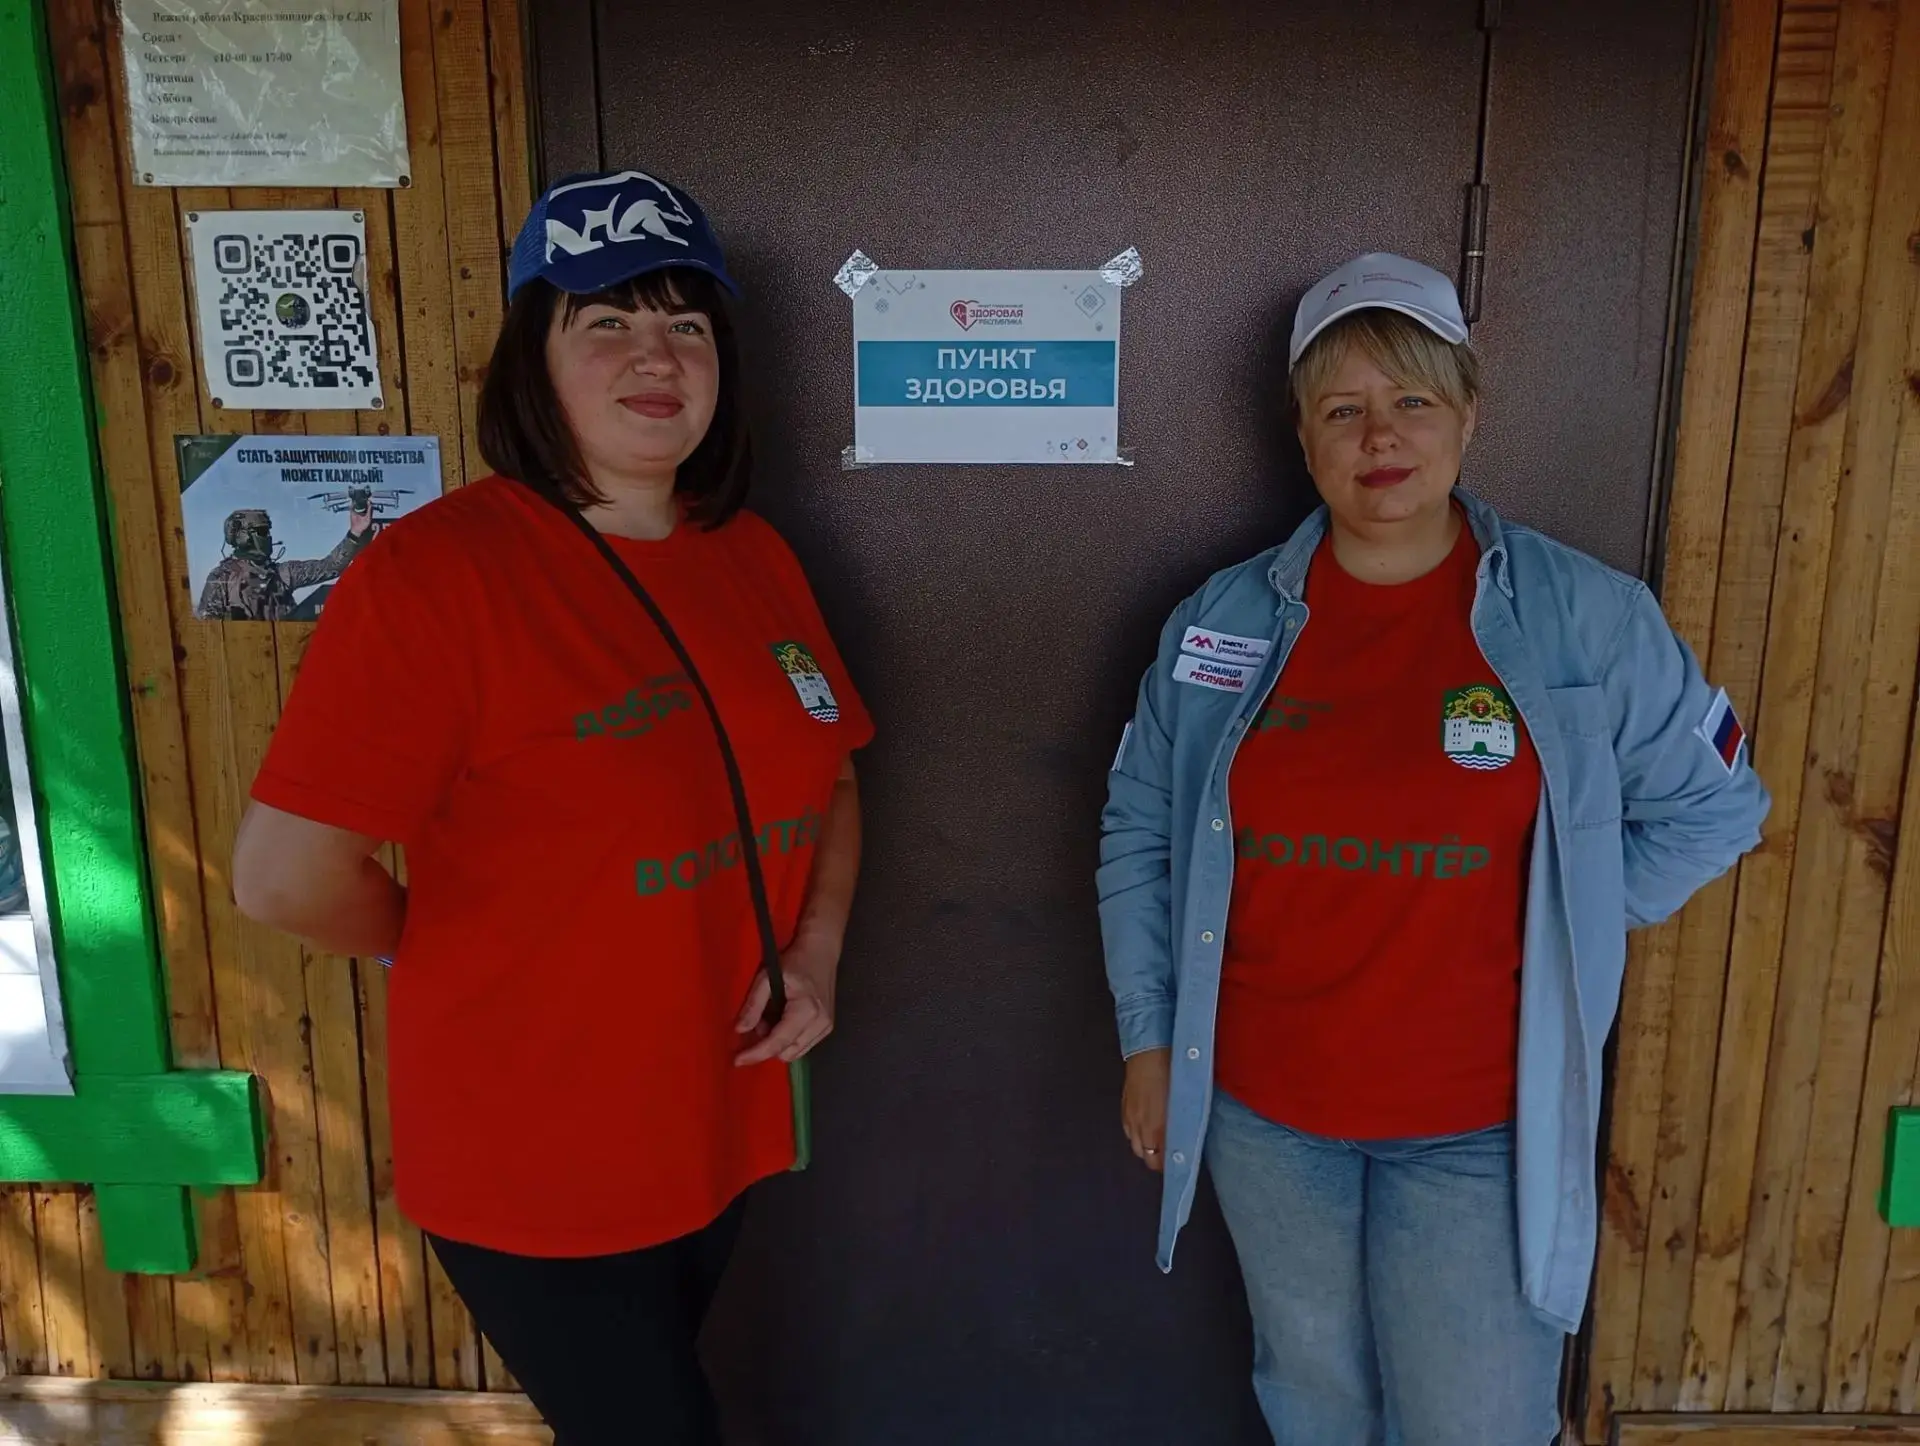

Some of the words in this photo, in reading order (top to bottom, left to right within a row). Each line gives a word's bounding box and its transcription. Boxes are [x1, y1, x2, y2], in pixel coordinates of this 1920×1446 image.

[142, 32, 175, 44] Среда
[265, 52, 292, 63] 17-00
[969, 309, 1024, 318] ЗДОРОВАЯ
[937, 348, 1037, 370] ПУНКТ
[905, 378, 1067, 403] ЗДОРОВЬЯ
[237, 449, 273, 464] СТАТЬ
[274, 449, 357, 465] ЗАЩИТНИКОМ
[358, 449, 425, 465] ОТЕЧЕСТВА
[281, 469, 324, 483] МОЖЕТ
[325, 466, 384, 485] КАЖДЫЙ!
[1198, 663, 1242, 678] КОМАНДА
[1189, 671, 1244, 688] РЕСПУБЛИКИ
